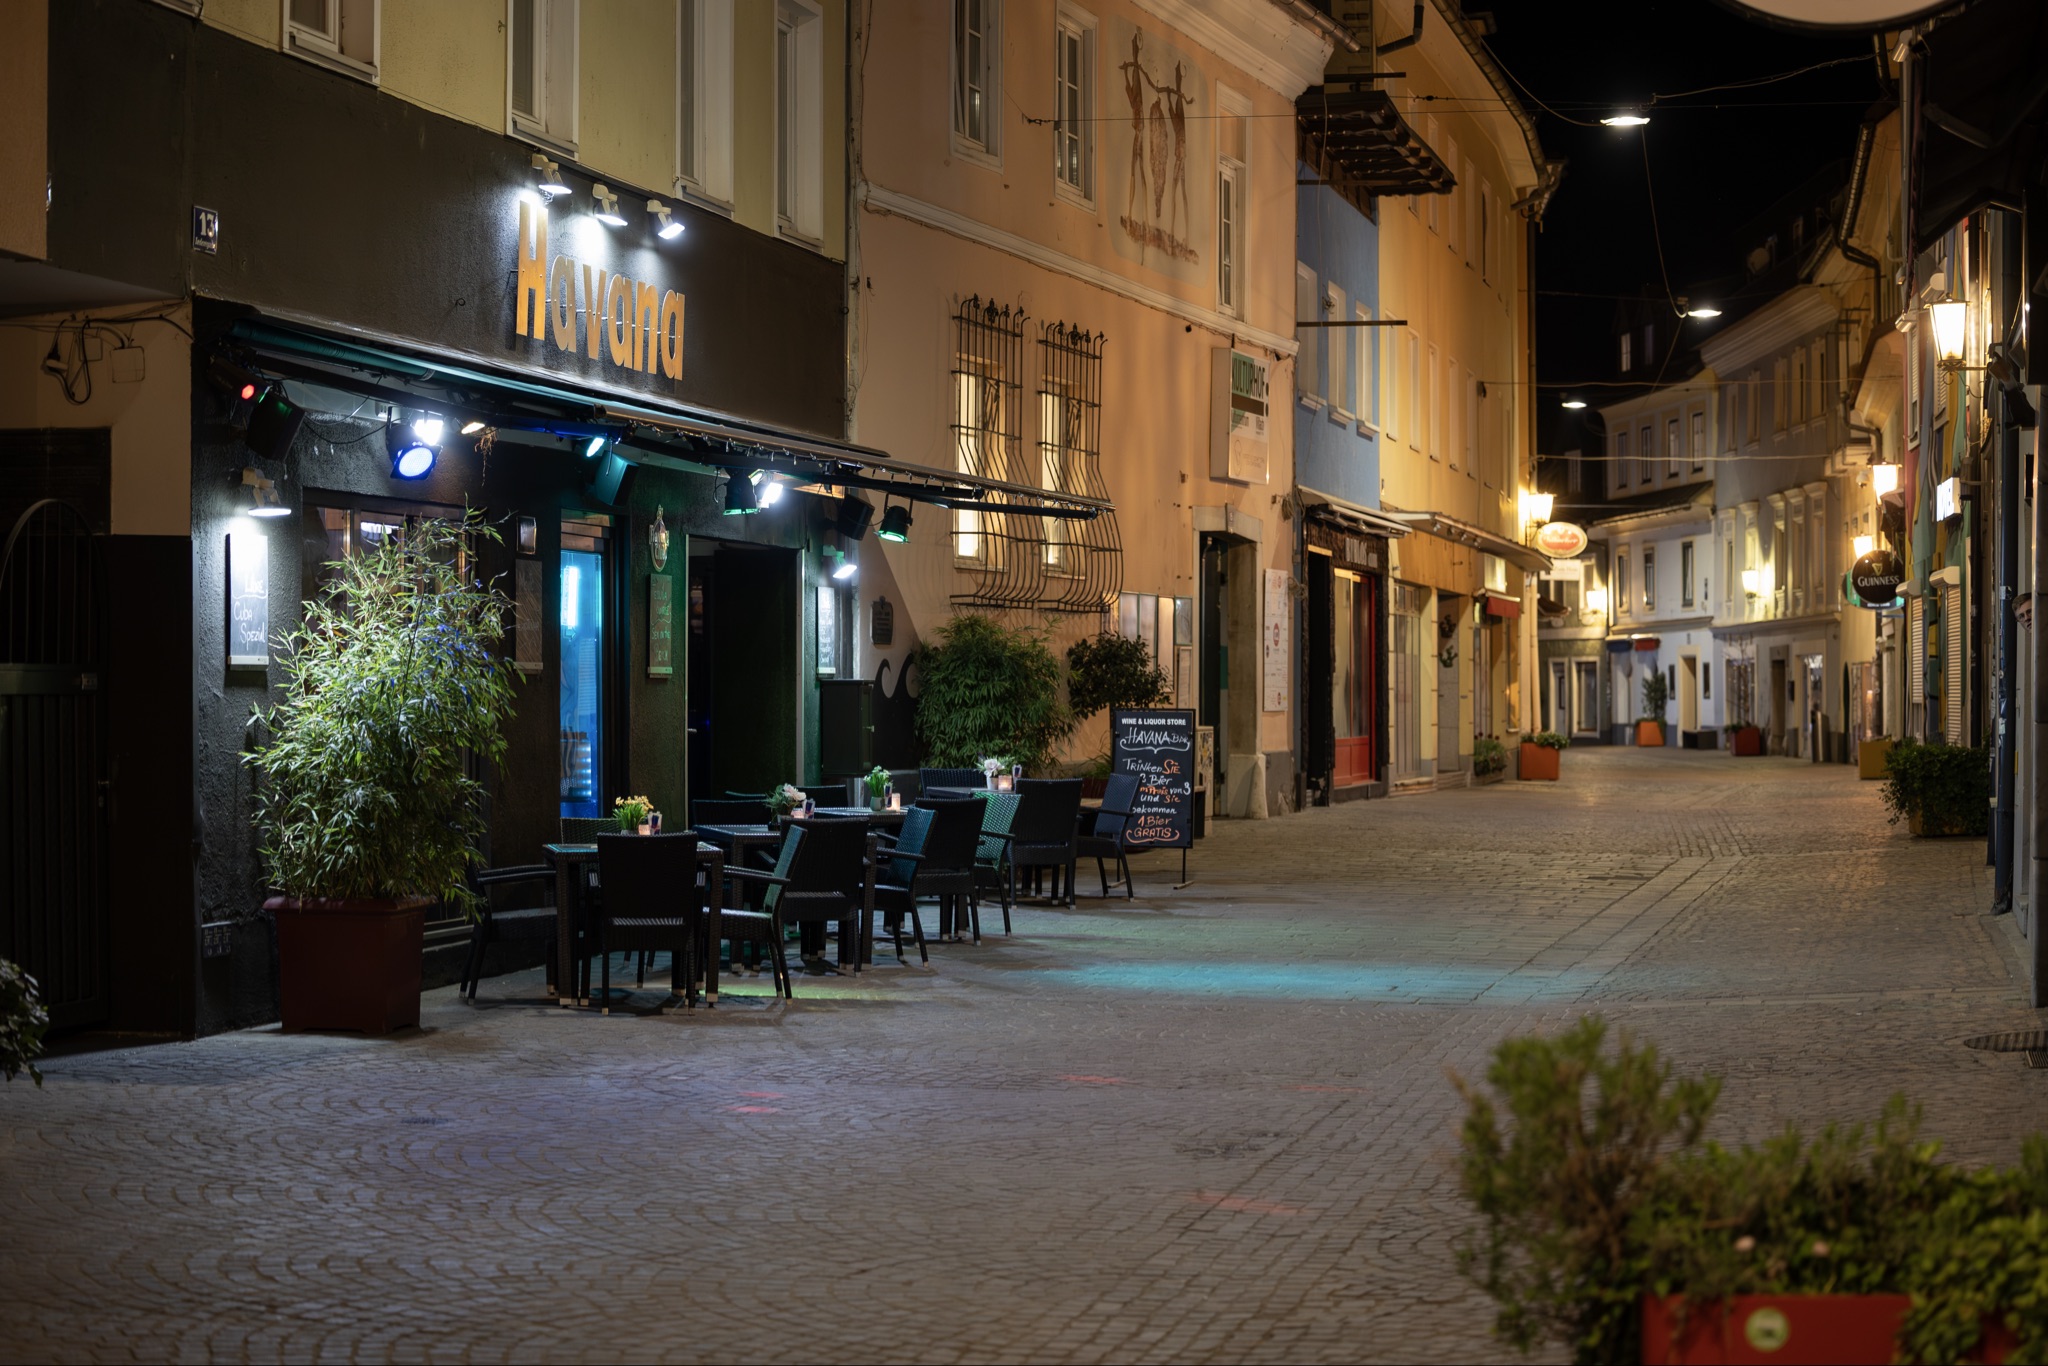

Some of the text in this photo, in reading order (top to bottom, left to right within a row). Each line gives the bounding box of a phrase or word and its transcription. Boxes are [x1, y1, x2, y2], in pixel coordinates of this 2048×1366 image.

[199, 212, 215, 238] 13
[516, 200, 685, 380] Havana
[1857, 576, 1900, 587] GUINNESS
[1144, 718, 1166, 726] LIQUOR
[1167, 718, 1186, 726] STORE
[1125, 727, 1171, 745] HAVANA
[1147, 774, 1173, 786] Bier
[1138, 815, 1172, 827] 1 Bier
[1134, 828, 1172, 838] GRATIS
